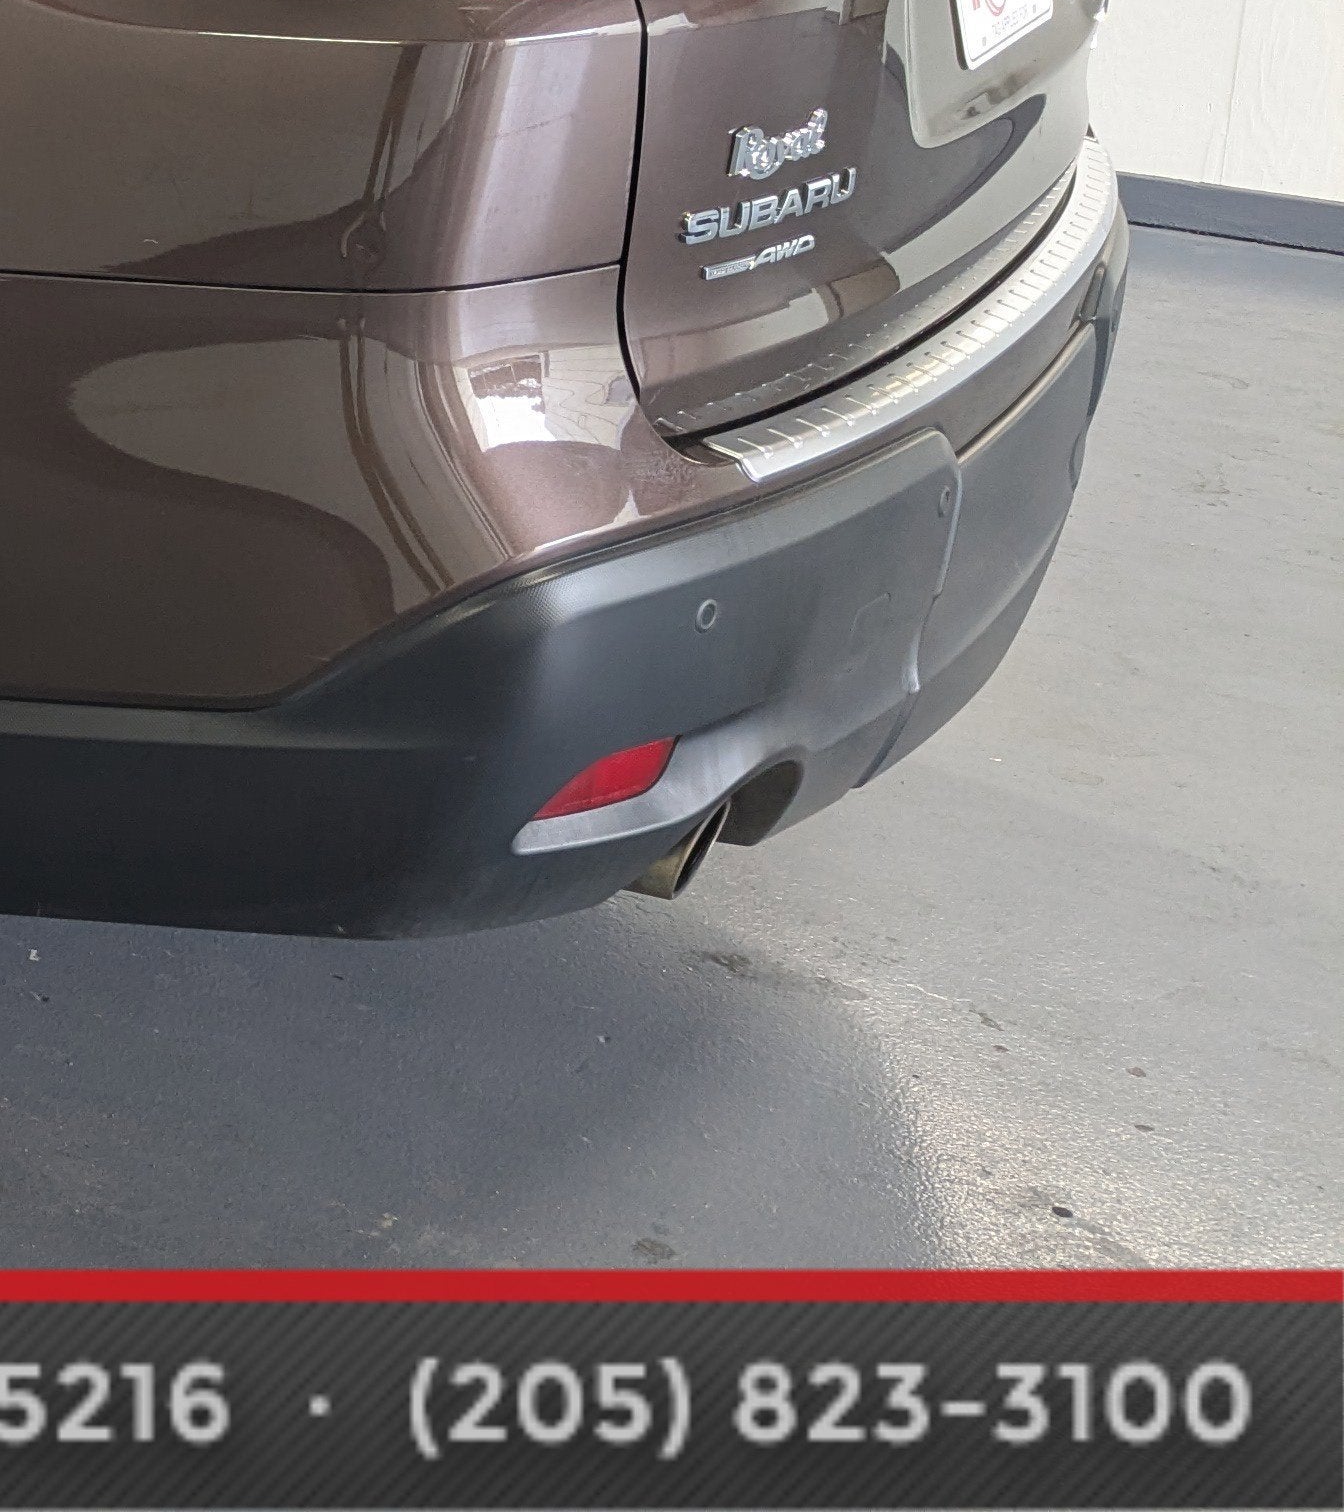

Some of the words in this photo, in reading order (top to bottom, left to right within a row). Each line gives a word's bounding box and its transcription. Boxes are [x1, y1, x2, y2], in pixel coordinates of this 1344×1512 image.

[727, 108, 828, 180] Royal
[682, 167, 857, 245] SUBARU
[750, 234, 815, 270] AWD
